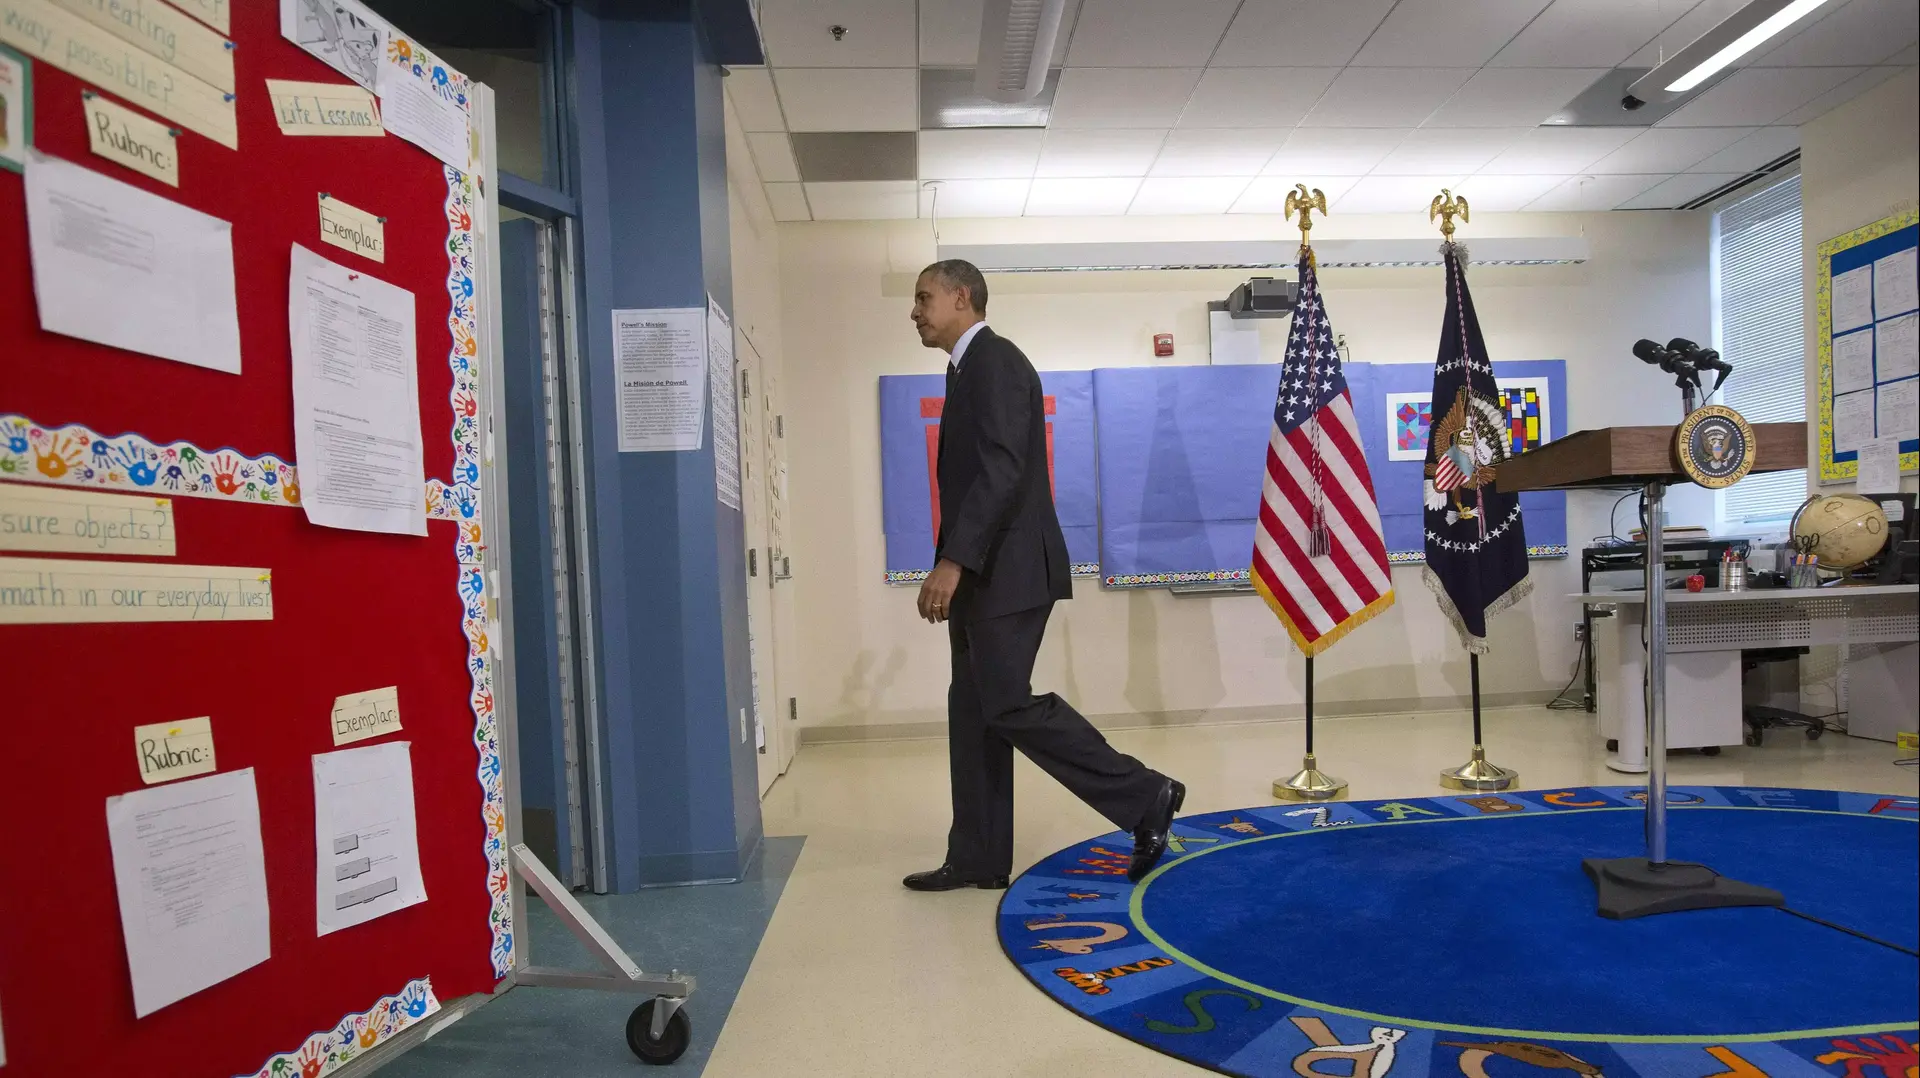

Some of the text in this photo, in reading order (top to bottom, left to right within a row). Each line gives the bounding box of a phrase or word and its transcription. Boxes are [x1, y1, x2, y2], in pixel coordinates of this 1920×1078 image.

[65, 38, 175, 110] possible?
[278, 95, 312, 125] Life
[94, 111, 172, 170] Rubric:
[319, 204, 382, 251] Exemplar:
[1681, 407, 1715, 445] PRESIDENT
[1736, 417, 1754, 453] UNITED
[1691, 467, 1711, 485] SEAL
[1725, 459, 1751, 485] STATES
[2, 504, 168, 548] sure objects?
[1, 571, 271, 619] math in our everyday lives?
[333, 702, 397, 735] Exemplar:
[141, 738, 210, 774] Rubric:
